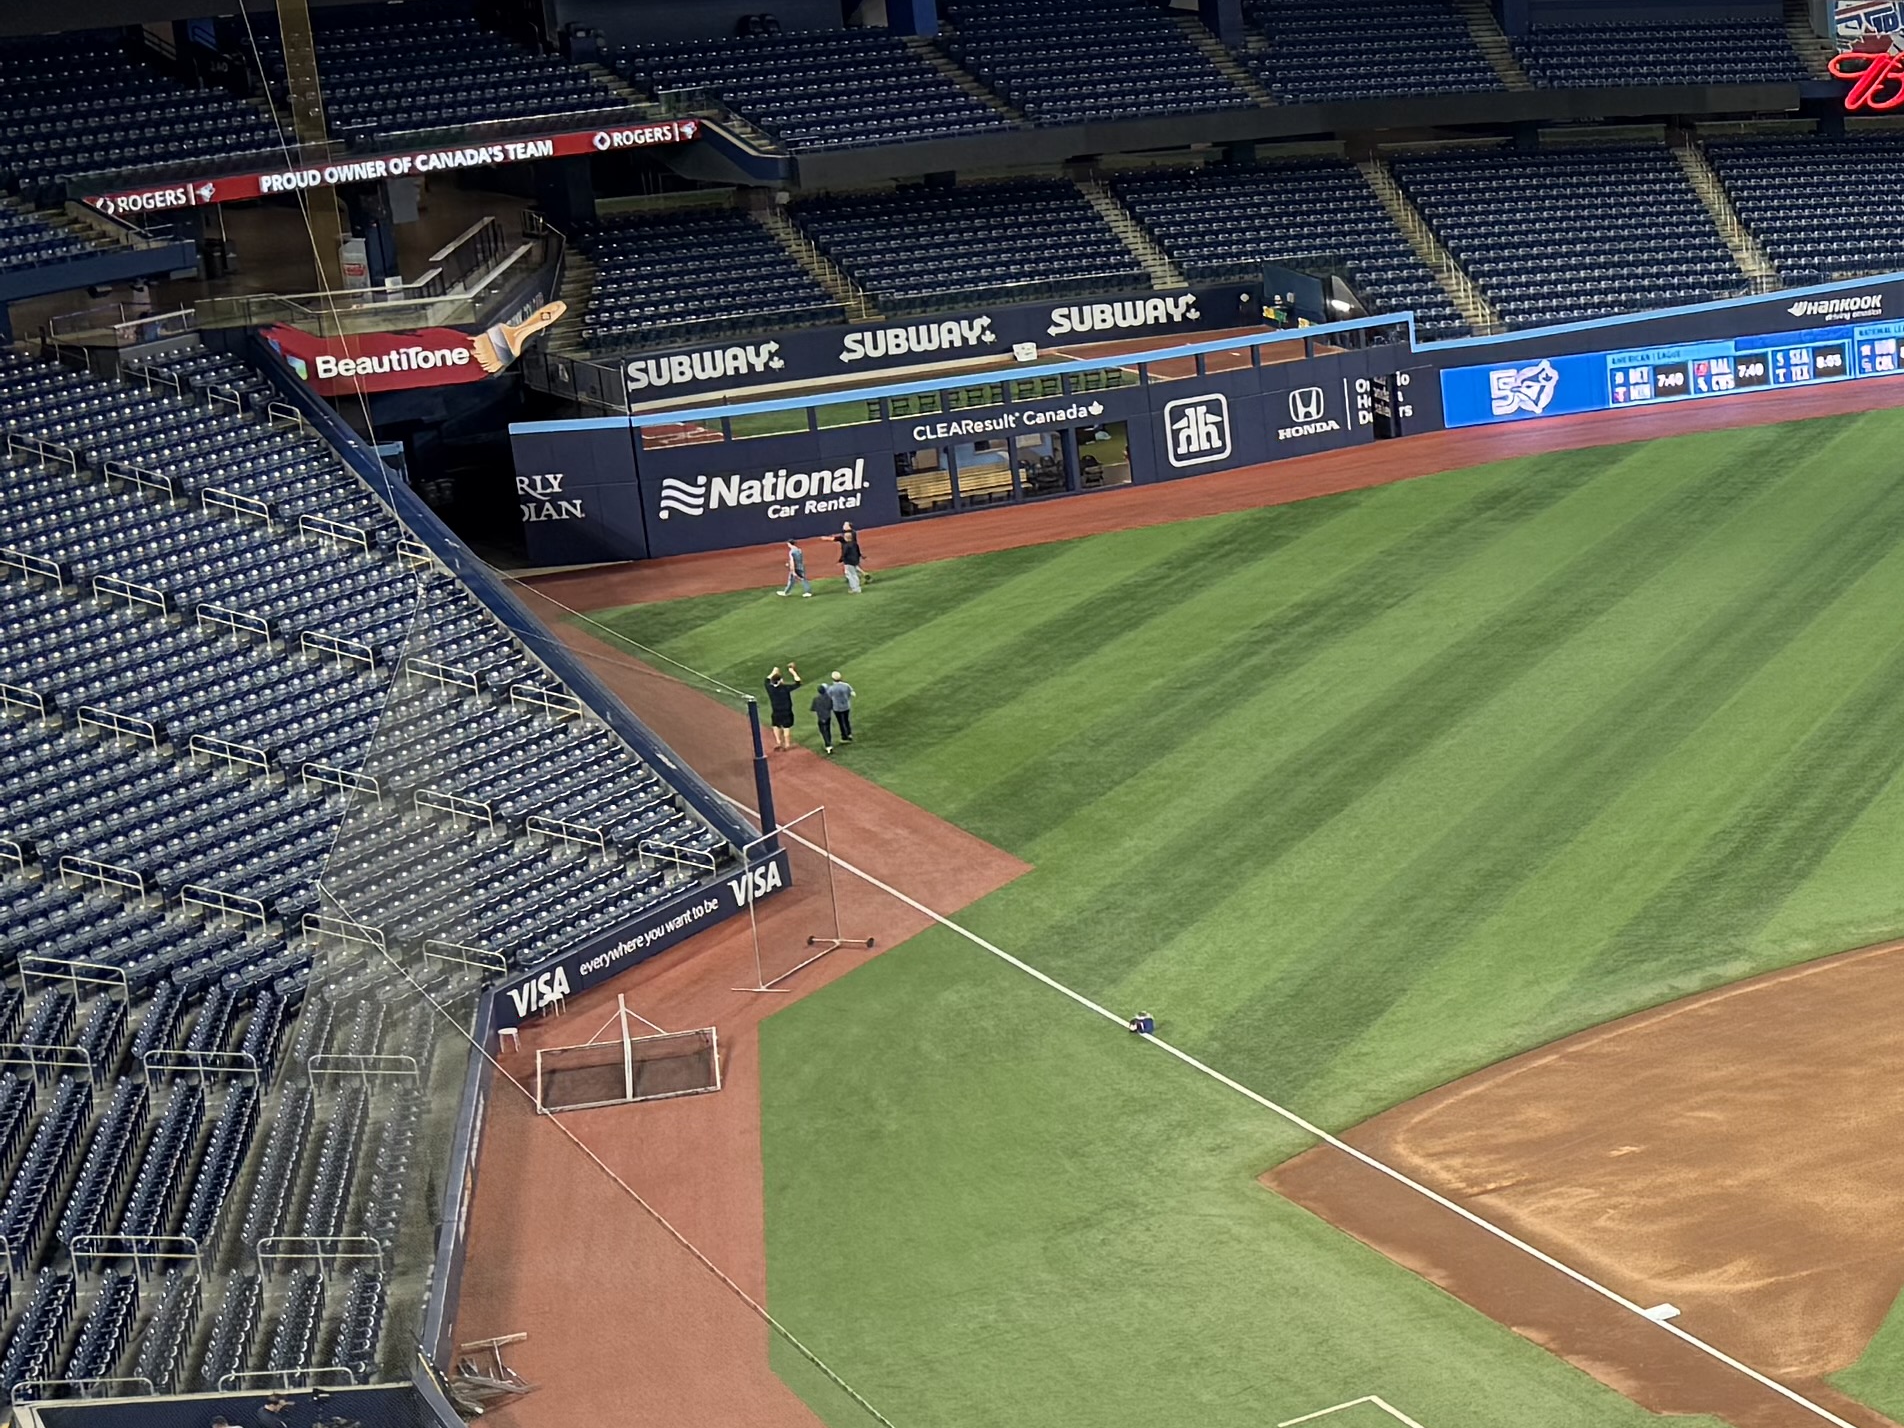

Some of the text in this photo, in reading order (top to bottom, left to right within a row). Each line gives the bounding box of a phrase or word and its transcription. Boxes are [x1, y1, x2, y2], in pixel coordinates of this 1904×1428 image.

[612, 125, 673, 147] ROGERS
[260, 140, 554, 193] PROUD OWNER OF CANADA'S TEAM
[117, 188, 186, 214] ROGERS
[1048, 293, 1200, 336] SUBWAY
[839, 316, 996, 363] SUBWAY
[316, 344, 470, 380] BeautiTone
[626, 341, 785, 392] SUBWAY
[913, 404, 1088, 441] CLEAResult Canada
[1278, 418, 1340, 440] HONDA
[768, 494, 861, 520] Car Rental
[727, 861, 782, 906] VISA
[580, 898, 718, 976] everywhere you want be
[507, 967, 570, 1017] VISA
